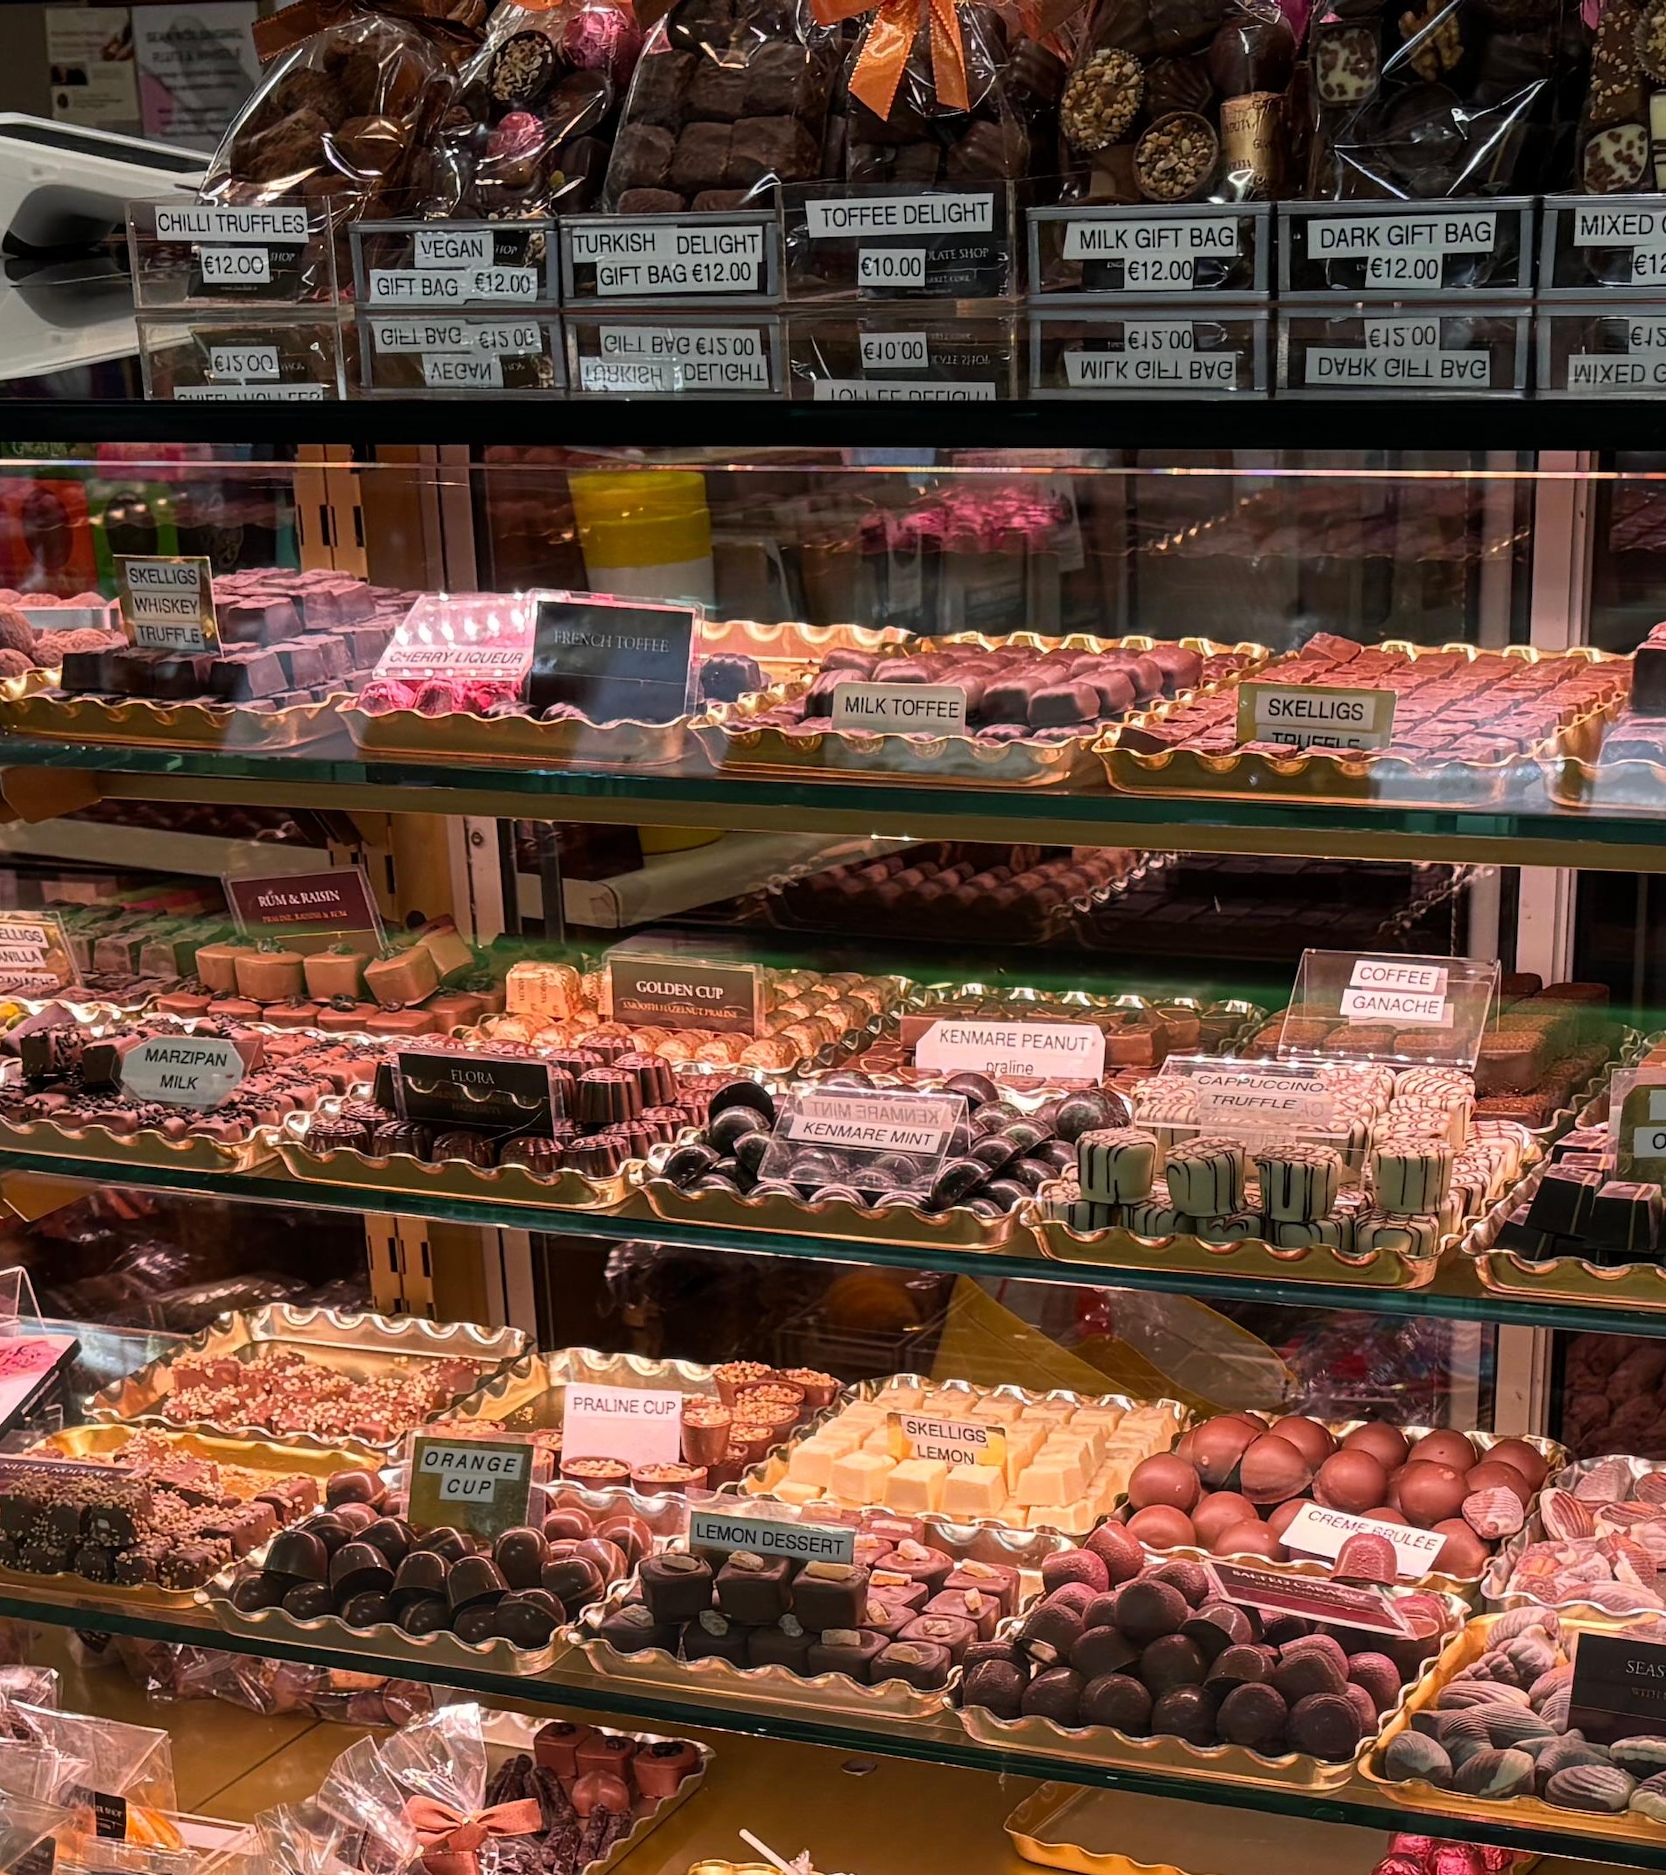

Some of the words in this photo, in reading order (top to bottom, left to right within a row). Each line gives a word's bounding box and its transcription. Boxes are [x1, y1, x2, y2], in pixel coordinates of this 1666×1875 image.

[158, 213, 211, 234] CHILLI
[216, 213, 305, 233] TRUFFLES
[821, 205, 898, 228] TOFFEE
[904, 202, 989, 225] DELIGHT
[1581, 213, 1654, 237] MIXED
[574, 233, 656, 254] TURKISH
[677, 234, 759, 255] DELIGHT
[1080, 229, 1128, 250] MILK
[1135, 227, 1183, 249] GIFT
[1190, 226, 1234, 249] BAG
[1321, 226, 1381, 250] DARK
[1388, 224, 1439, 246] GIFT
[1445, 221, 1492, 244] BAG
[421, 238, 483, 258] VEGAN
[204, 254, 264, 275] €12.00
[599, 266, 642, 286] GIFT
[648, 264, 688, 284] BAG
[692, 262, 751, 283] €12.00
[861, 257, 922, 278] €10.00
[1128, 260, 1193, 282] €12.00
[1370, 257, 1439, 280] €12.00
[377, 279, 415, 296] GIFT
[421, 277, 459, 296] BAG
[474, 273, 531, 294] €12.00
[130, 566, 198, 587] SKELLIGS
[134, 597, 199, 618] WHISKEY
[135, 624, 201, 644] TRUFFLE
[389, 647, 439, 665] CHERRY
[443, 647, 524, 667] LIQUEUR
[845, 695, 889, 717] MILK
[895, 696, 962, 719] TOFFEE
[1267, 697, 1364, 722] SKELLIGS
[1359, 966, 1432, 986] COFFEE
[635, 980, 693, 998] GOLDEN
[695, 984, 724, 1000] CUP
[1351, 994, 1440, 1015] GANACHE
[939, 1028, 1016, 1048] KENMARE
[1023, 1031, 1089, 1052] PEANUT
[145, 1046, 227, 1071] MARZIPAN
[160, 1073, 198, 1093] MILK
[450, 1068, 495, 1086] FLORA
[1211, 1094, 1298, 1110] TRUFFLE
[803, 1121, 888, 1142] KENMARE
[889, 1130, 935, 1147] MINT
[573, 1395, 638, 1414] PRALINE
[641, 1397, 677, 1415] CUP
[906, 1418, 988, 1445] SKELLIGS
[424, 1449, 524, 1475] ORANGE
[916, 1443, 976, 1466] LEMON
[445, 1476, 493, 1497] CUP
[695, 1521, 761, 1548] LEMON
[763, 1529, 845, 1557] DESSERT
